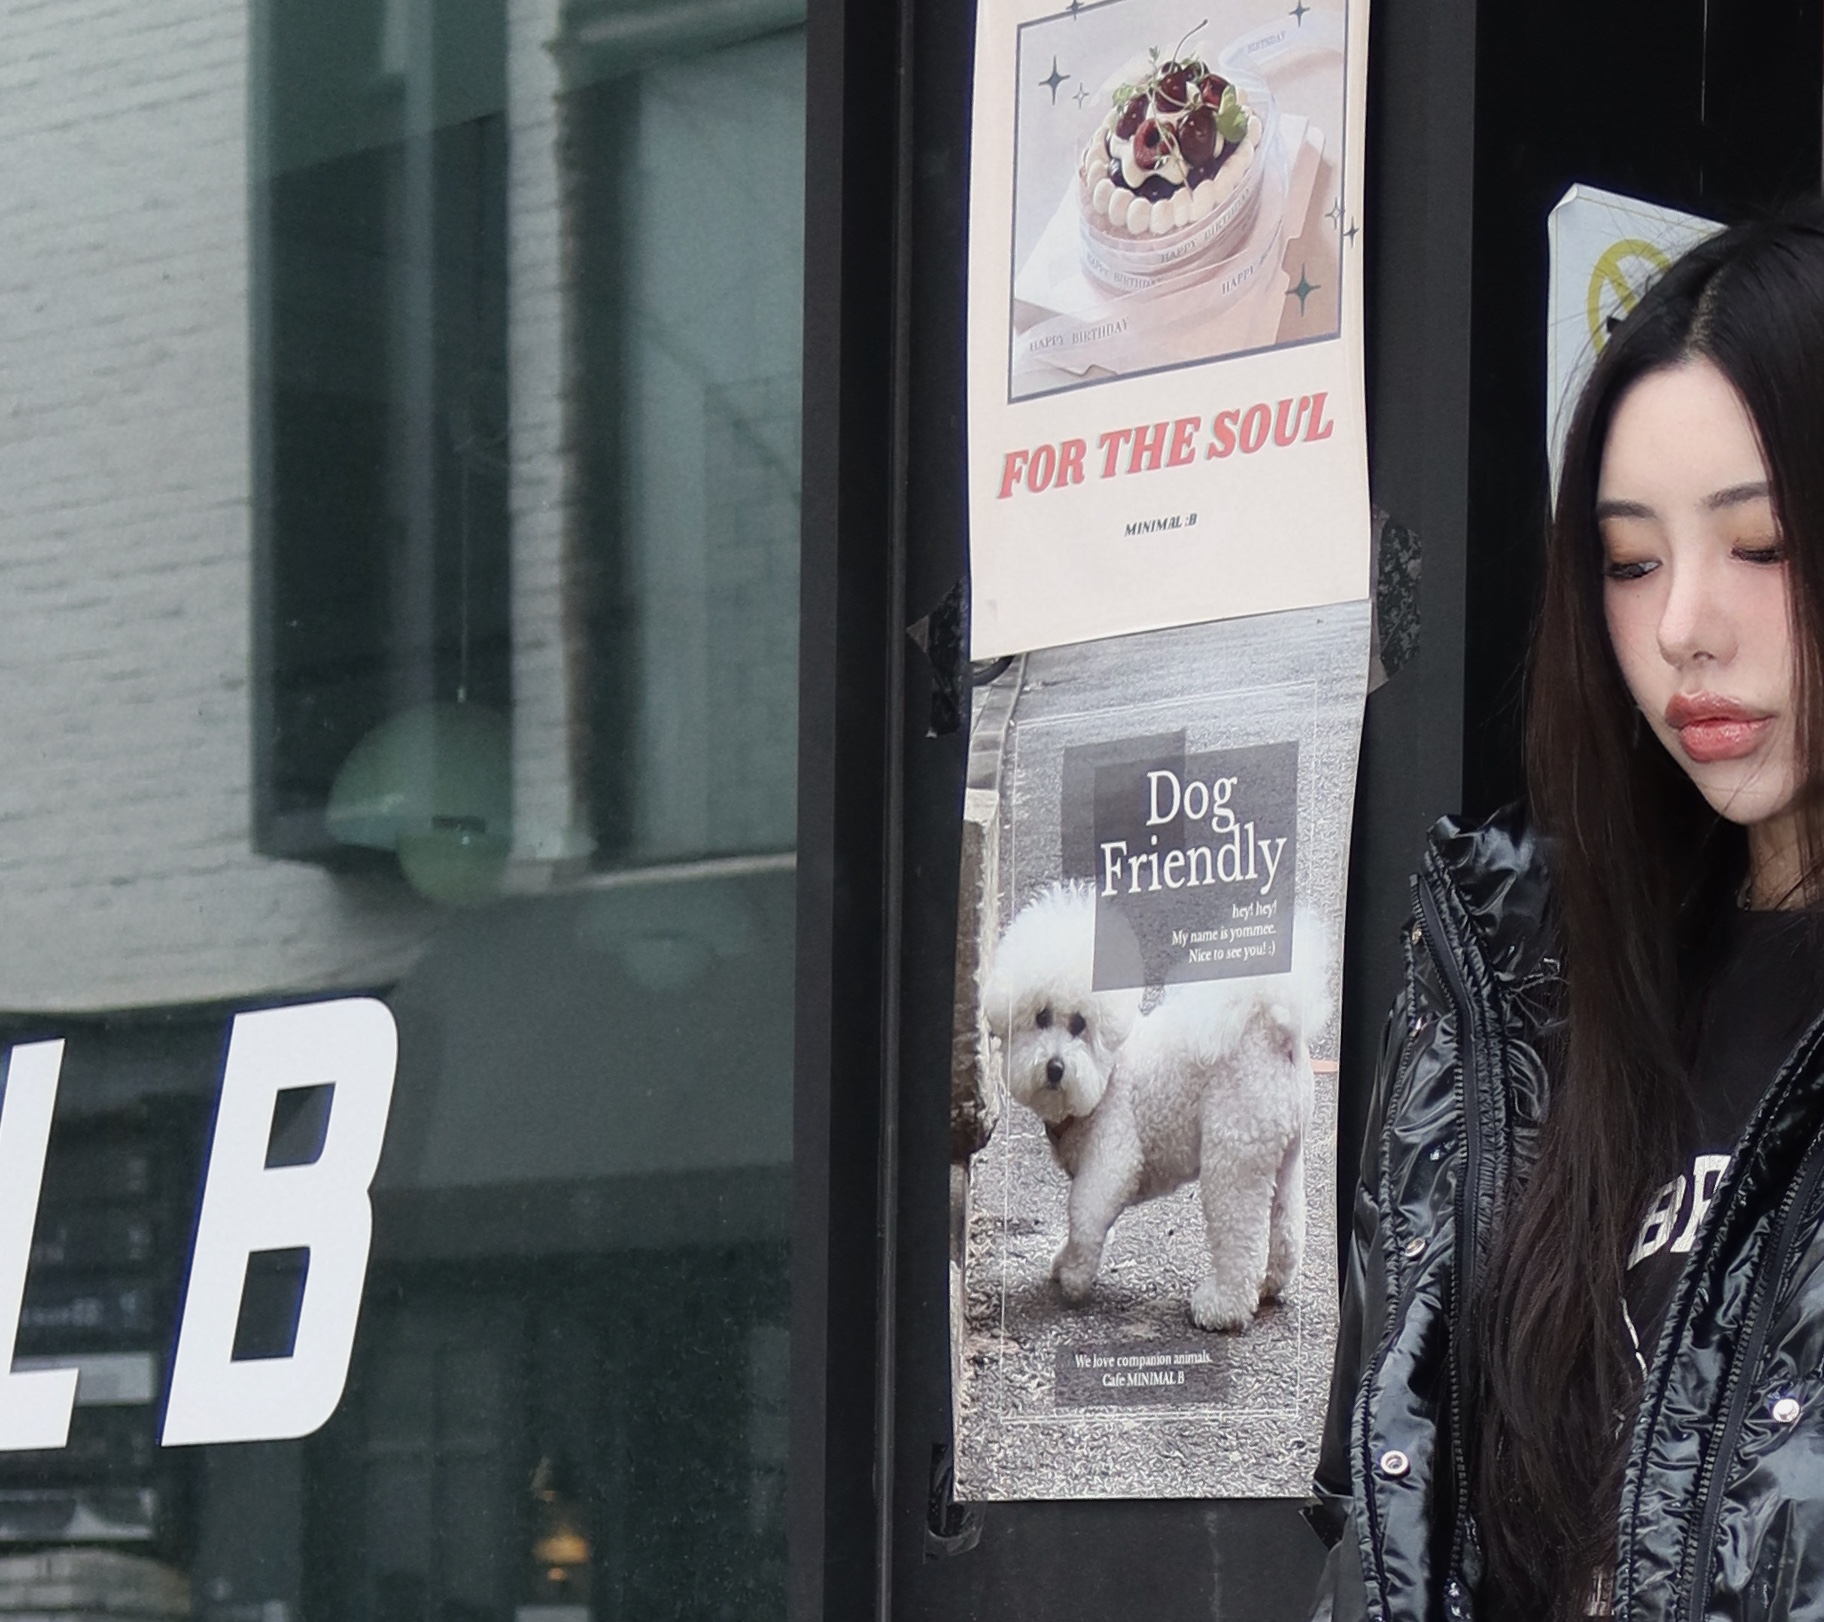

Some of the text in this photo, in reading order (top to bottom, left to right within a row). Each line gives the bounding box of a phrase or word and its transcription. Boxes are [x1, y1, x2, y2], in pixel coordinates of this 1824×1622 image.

[1029, 316, 1129, 352] HAPPY BIRTHDAY
[997, 392, 1334, 499] FOR THE SOUL
[1124, 515, 1184, 537] MINIMAL
[1146, 769, 1238, 834] Dog
[1100, 821, 1287, 897] Friendly
[1232, 902, 1253, 919] hey!
[1171, 930, 1189, 947] My
[1190, 929, 1218, 943] name
[1220, 925, 1229, 940] is
[1188, 946, 1212, 964] Nice
[1213, 947, 1225, 960] to
[1225, 947, 1243, 960] see
[1243, 941, 1266, 961] you!
[162, 996, 400, 1447] B
[1075, 1353, 1092, 1368] We
[1093, 1353, 1115, 1368] love
[1116, 1352, 1172, 1370] companion
[1102, 1370, 1185, 1388] Cafe MINIMAL B
